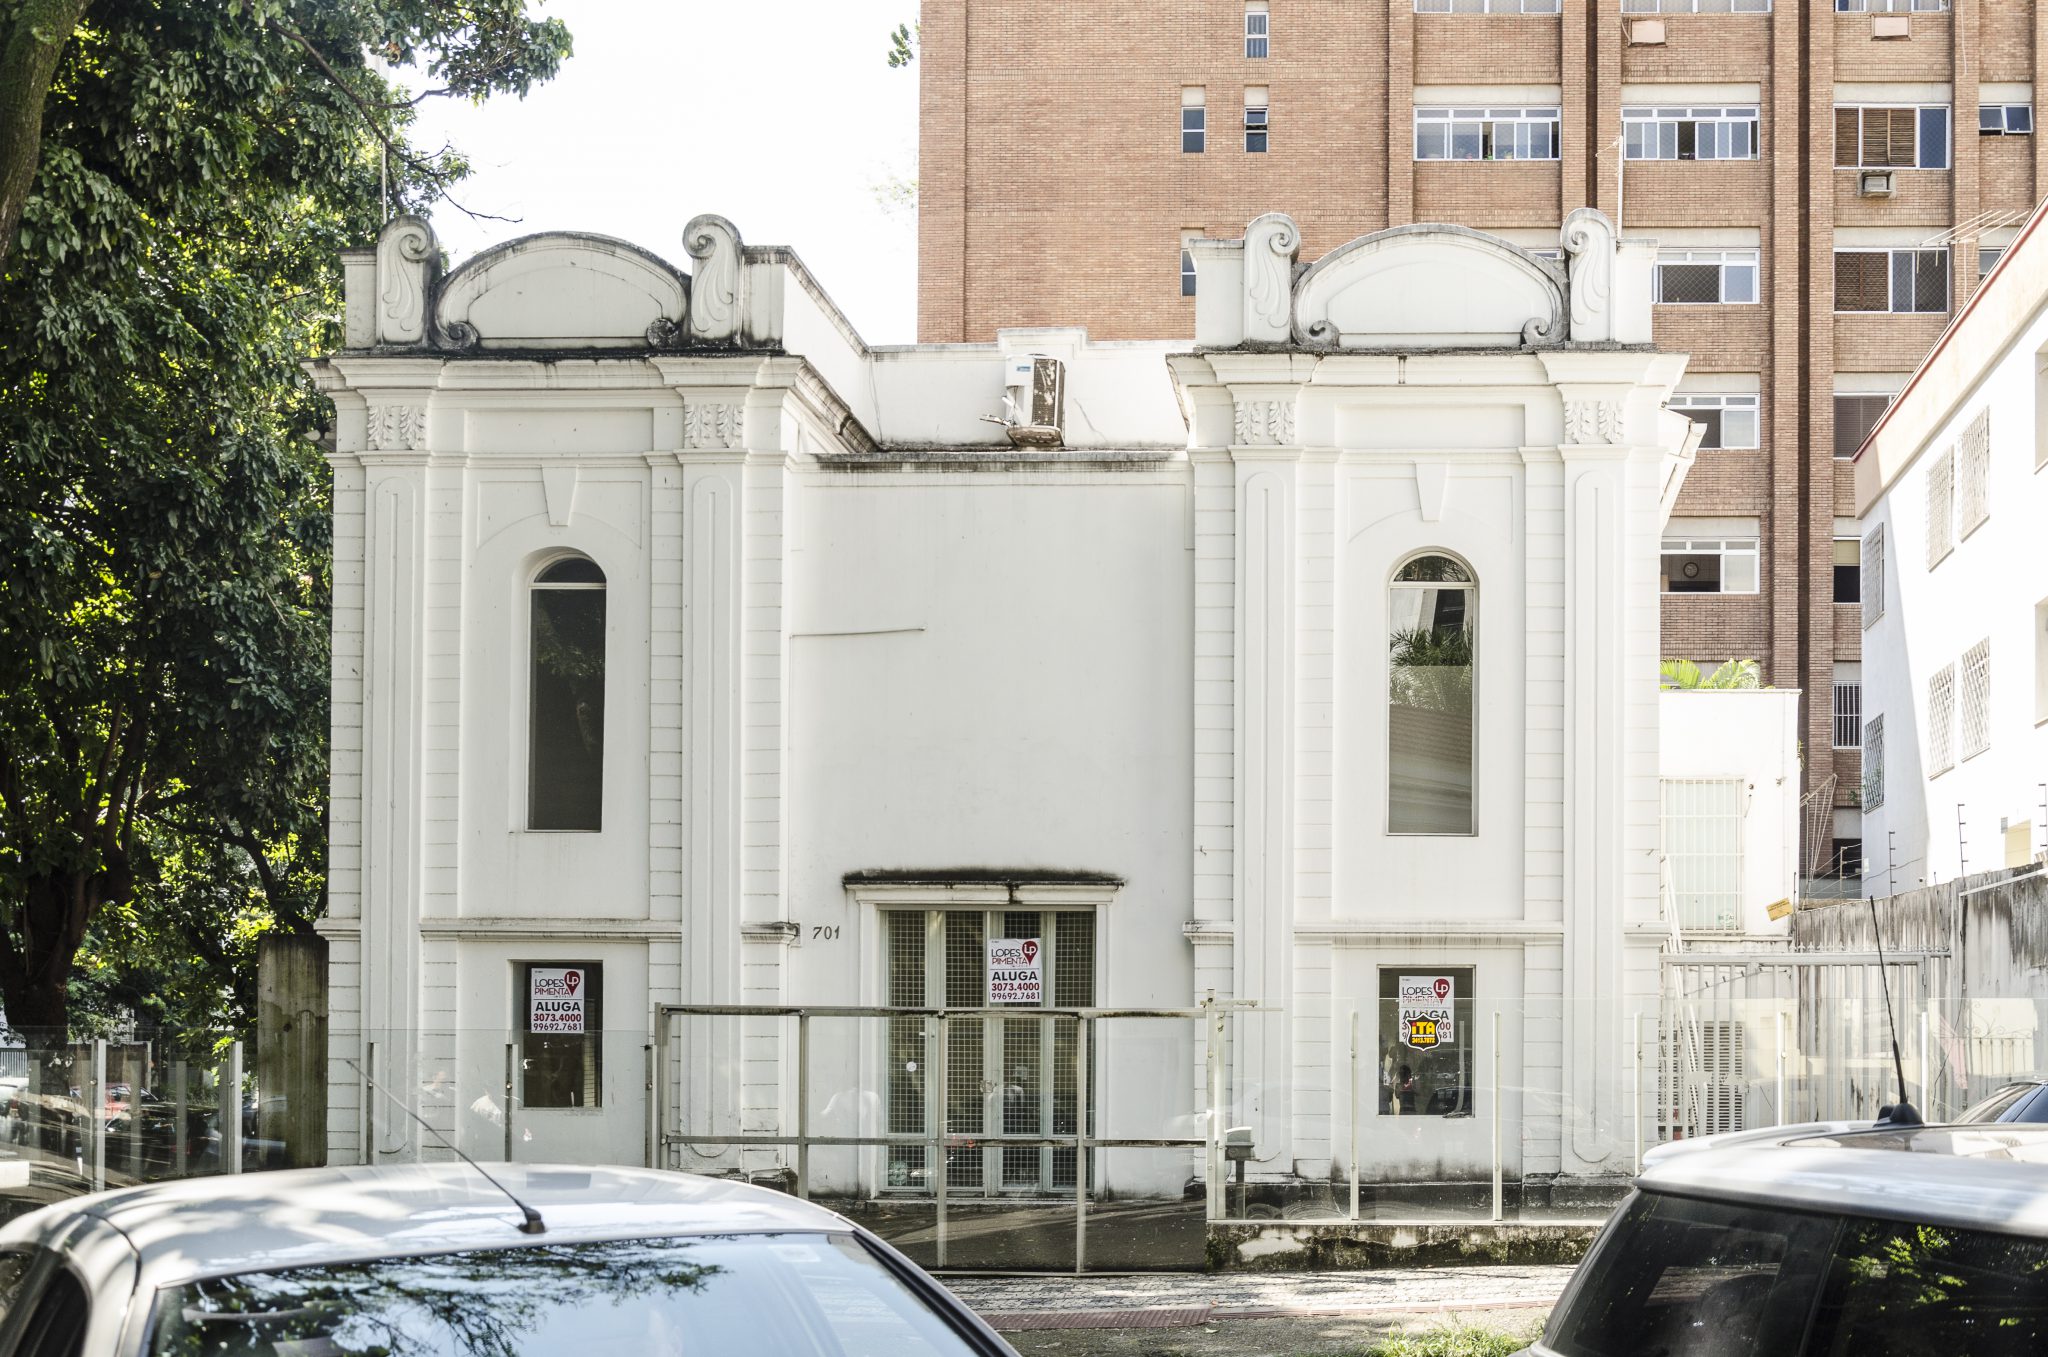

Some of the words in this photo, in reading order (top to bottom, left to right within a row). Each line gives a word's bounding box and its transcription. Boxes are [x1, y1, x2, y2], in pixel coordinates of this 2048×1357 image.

[813, 925, 840, 940] 701
[991, 948, 1021, 957] LOPES
[991, 957, 1028, 965] PIMENTA
[992, 971, 1038, 981] ALUGA
[534, 978, 565, 988] LOPES
[991, 982, 1040, 991] 3073.4000
[534, 988, 570, 996] PIMENTA
[991, 992, 1040, 1000] 99692.7681
[1402, 987, 1433, 996] LOPES
[535, 1001, 581, 1012] ALUGA
[533, 1013, 582, 1022] 3073.4000
[533, 1023, 582, 1031] 99692.7681
